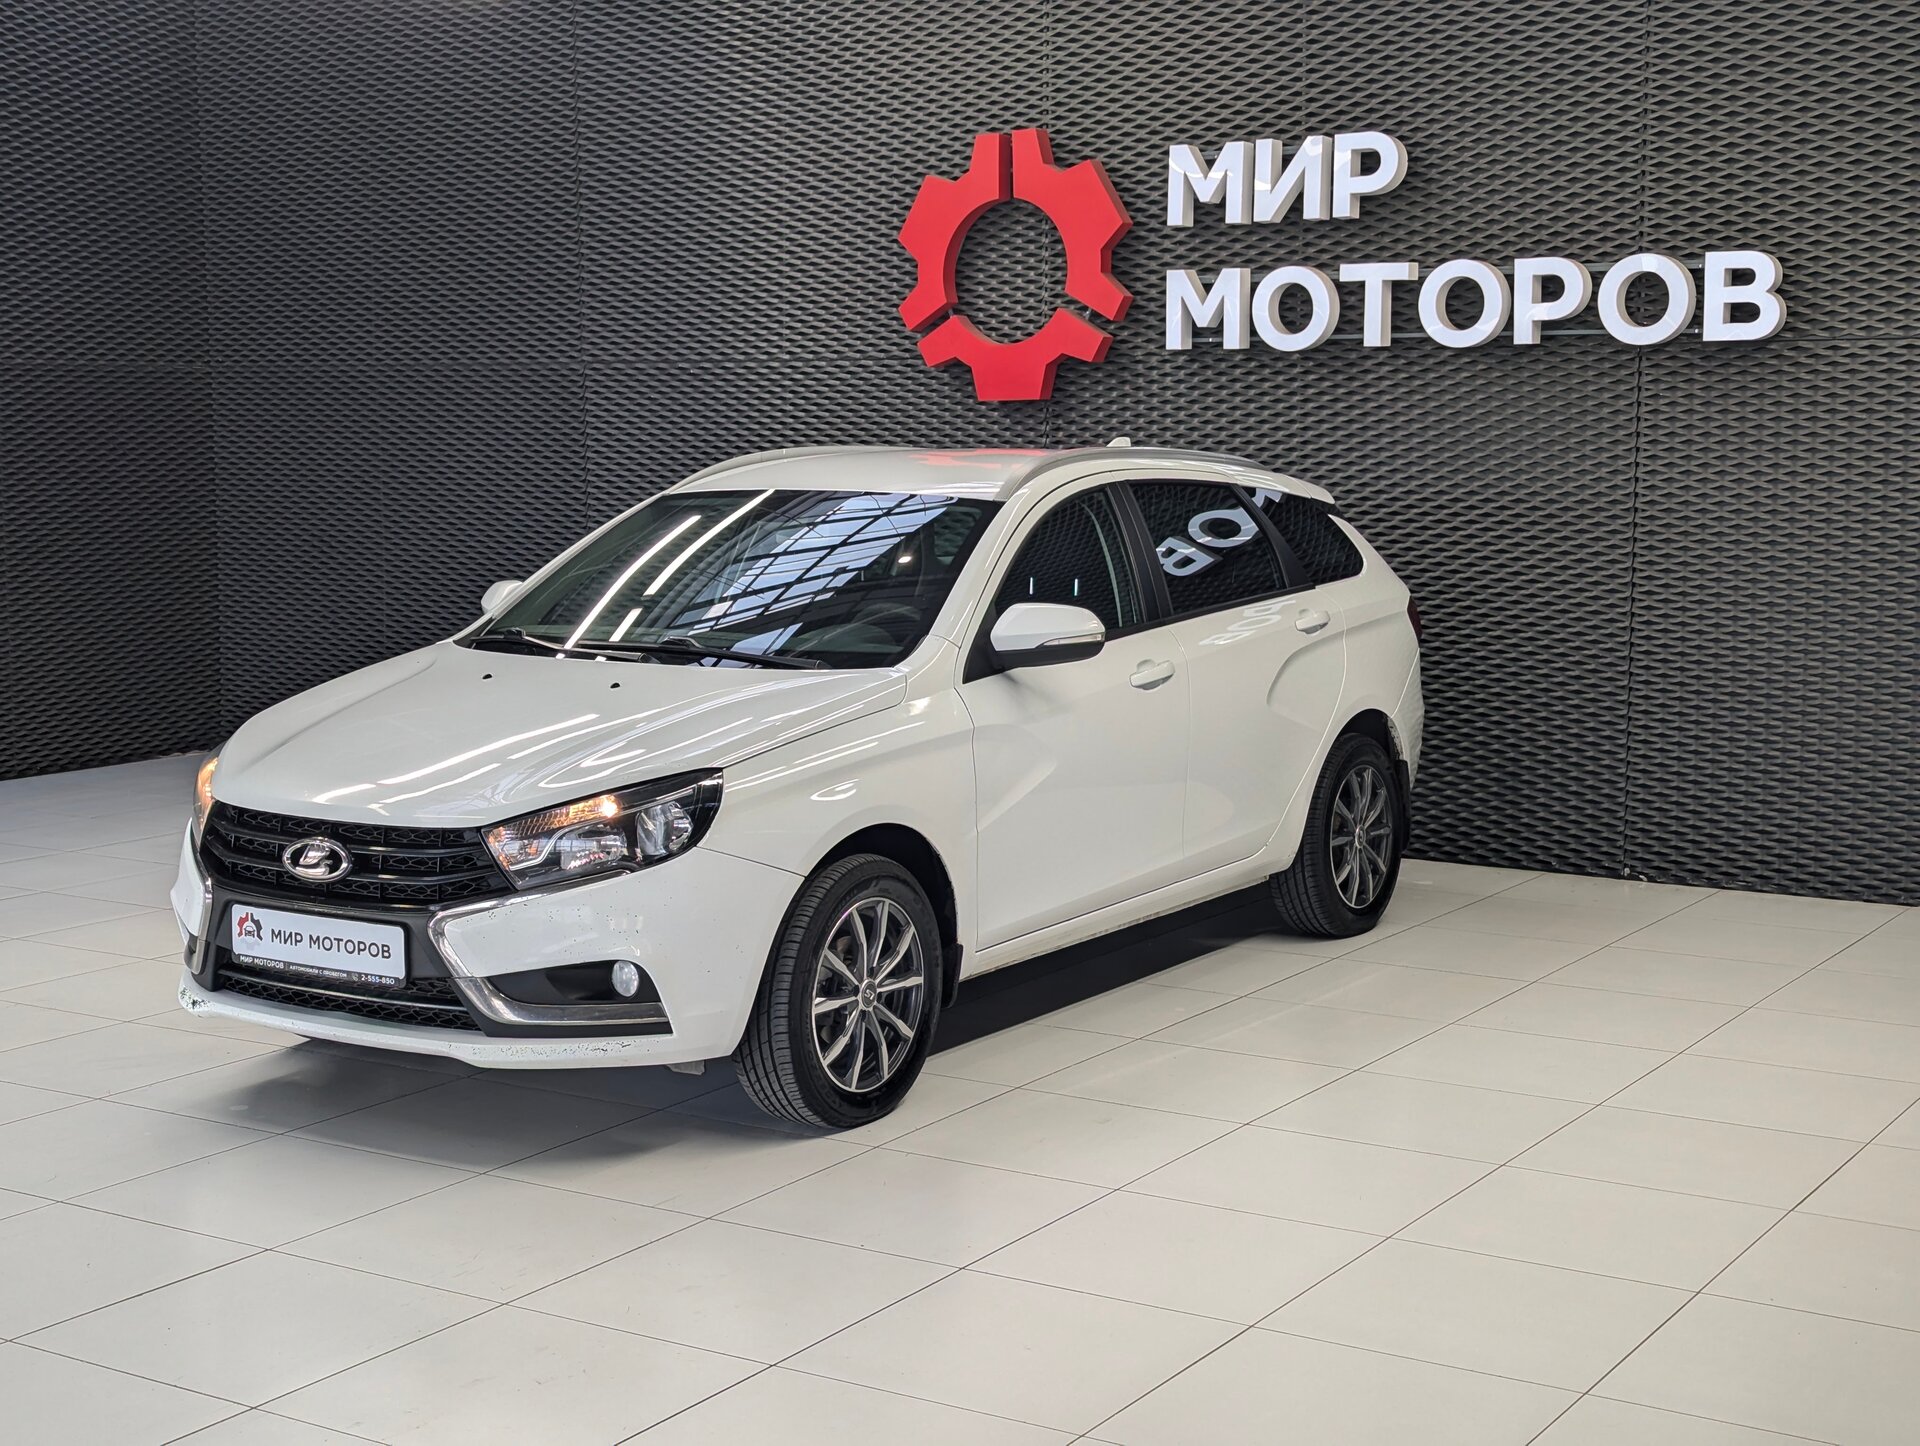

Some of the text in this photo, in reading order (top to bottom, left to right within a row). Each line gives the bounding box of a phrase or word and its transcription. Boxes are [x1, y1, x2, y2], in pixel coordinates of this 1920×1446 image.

[1166, 130, 1408, 227] МИР
[1165, 250, 1788, 352] МОТОРОВ
[240, 955, 253, 963] МИР
[254, 957, 285, 969] МОТОРОВ
[270, 928, 392, 959] МИР МОТОРОВ
